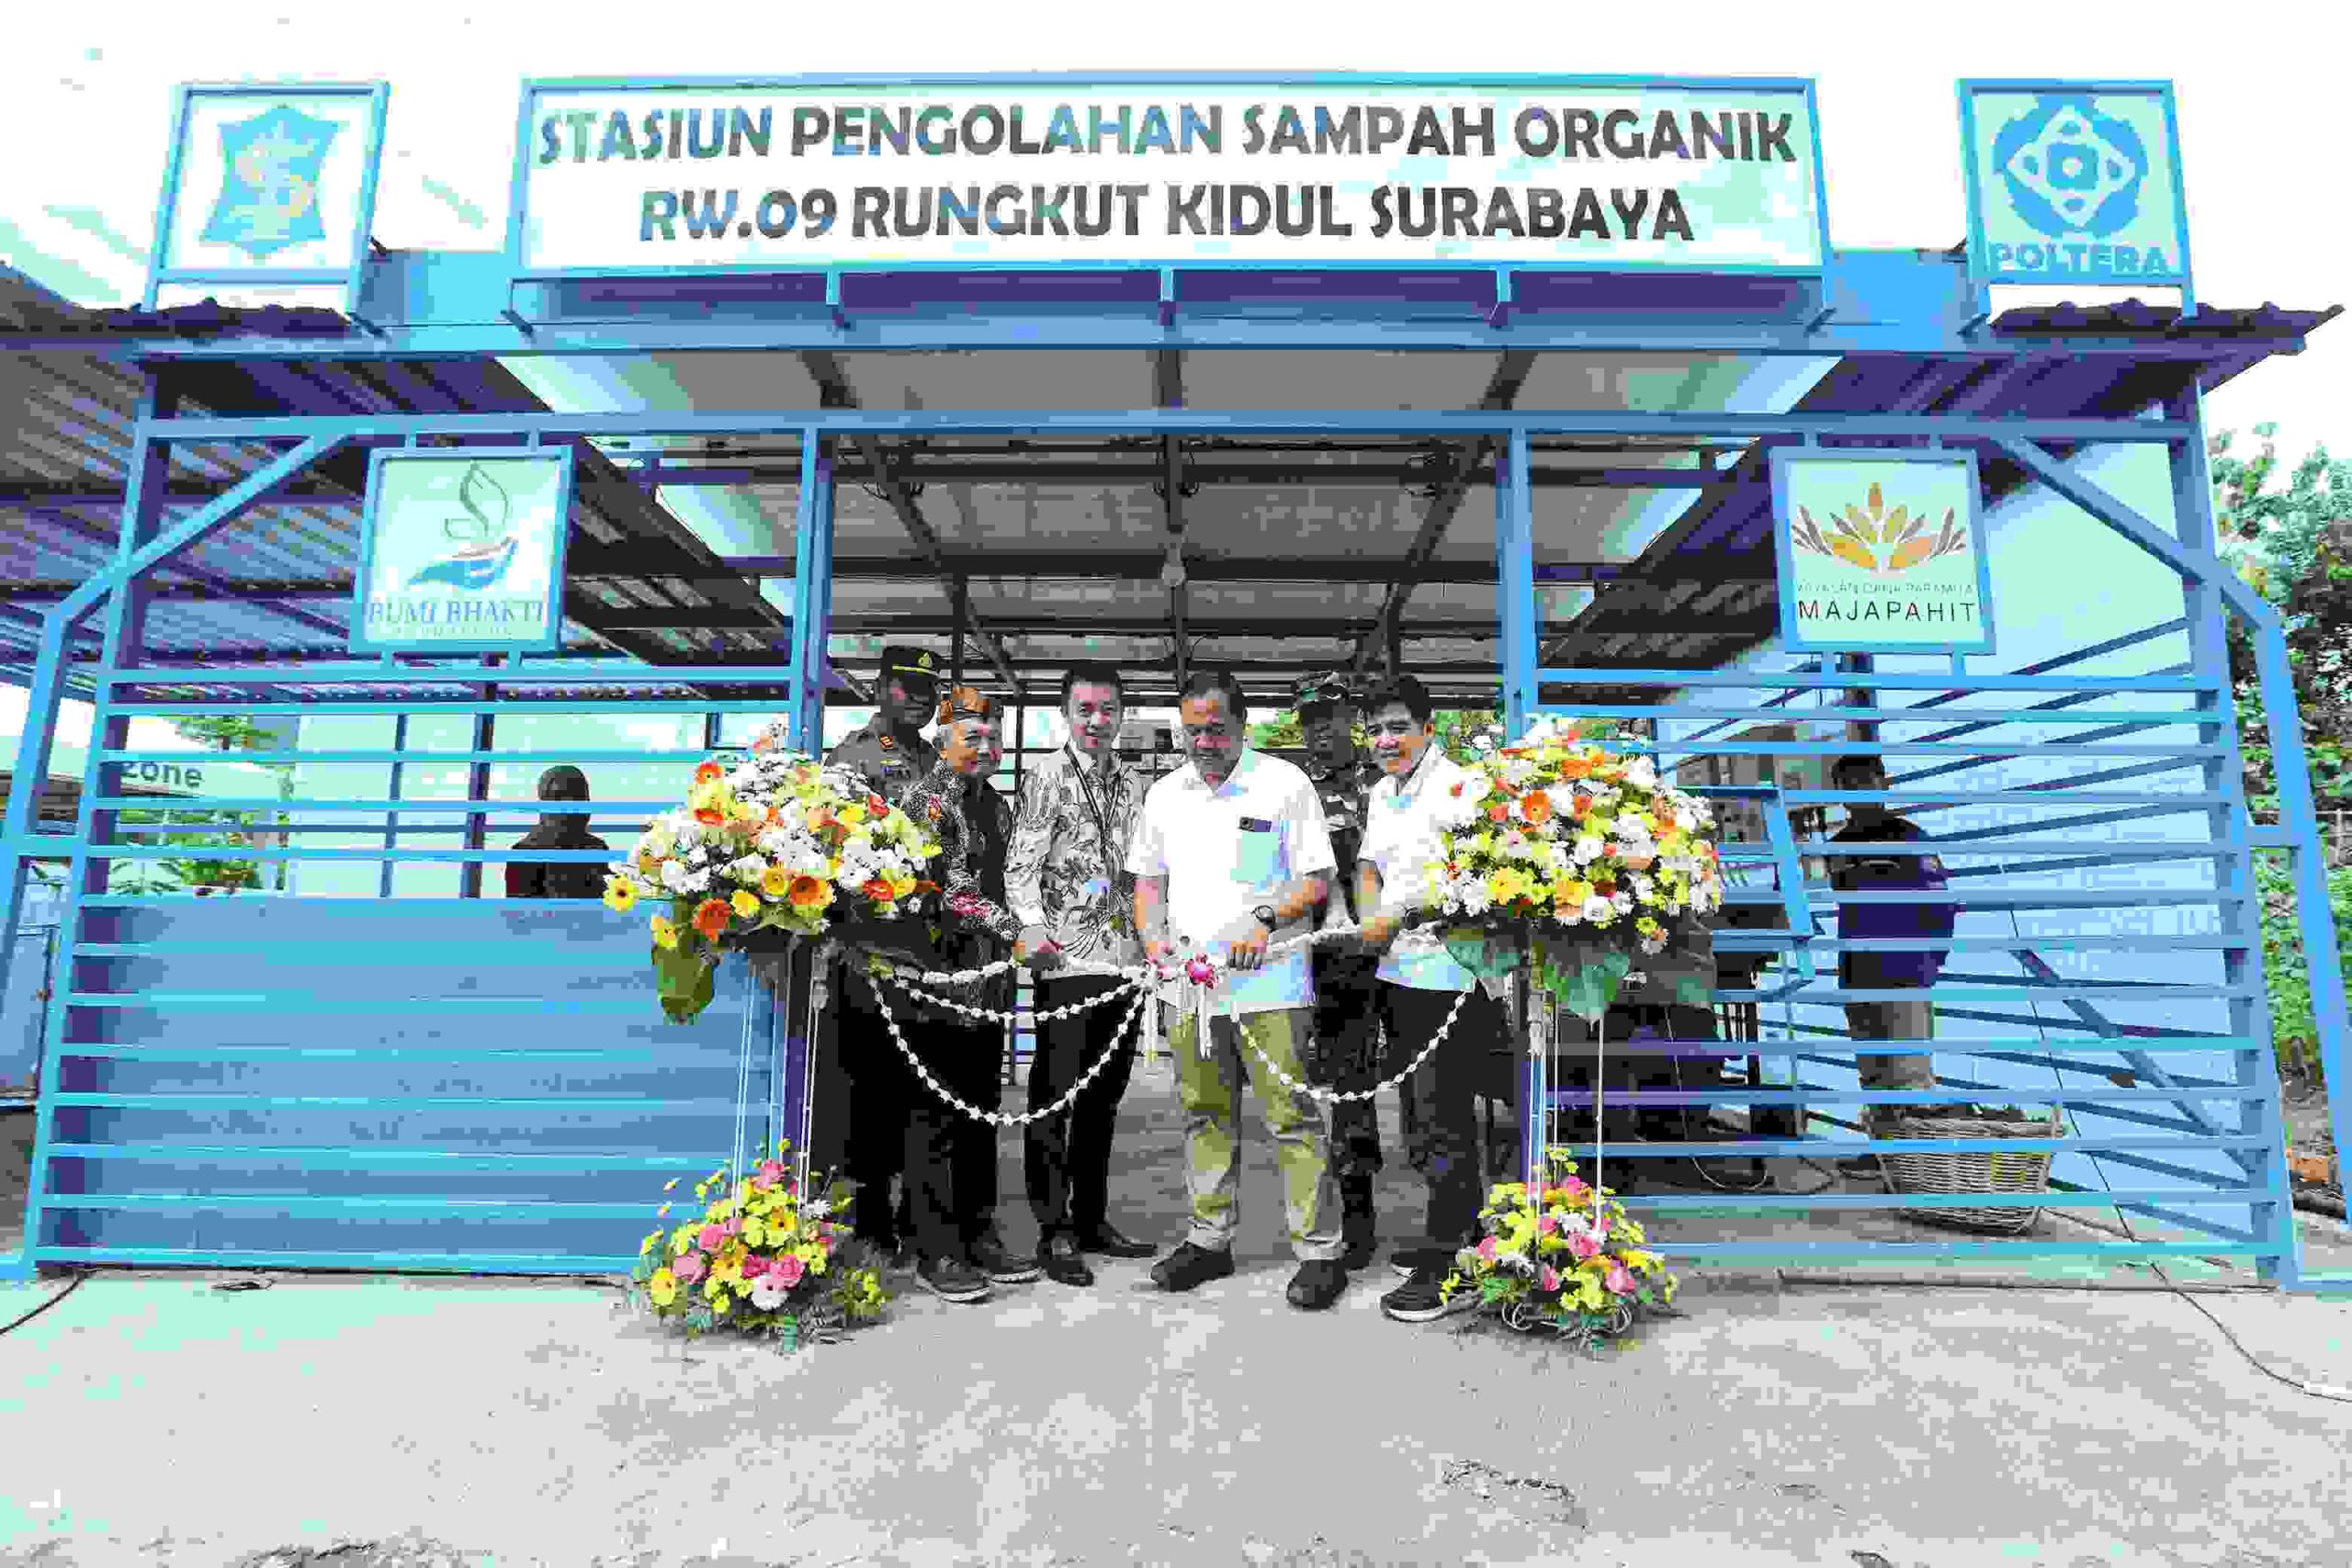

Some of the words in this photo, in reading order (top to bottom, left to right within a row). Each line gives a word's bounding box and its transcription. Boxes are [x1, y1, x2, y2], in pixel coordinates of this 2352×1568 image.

[539, 107, 773, 164] STASIUN
[791, 104, 1222, 157] PENGOLAHAN
[1242, 104, 1495, 157] SAMPAH
[1514, 107, 1797, 162] ORGANIK
[639, 187, 838, 242] RW.09
[851, 185, 1148, 238] RUNGKUT
[1167, 185, 1351, 237] KIDUL
[1370, 185, 1694, 242] SURABAYA
[1989, 243, 2183, 276] POLTERA
[1797, 600, 1976, 623] MAJAPAHIT
